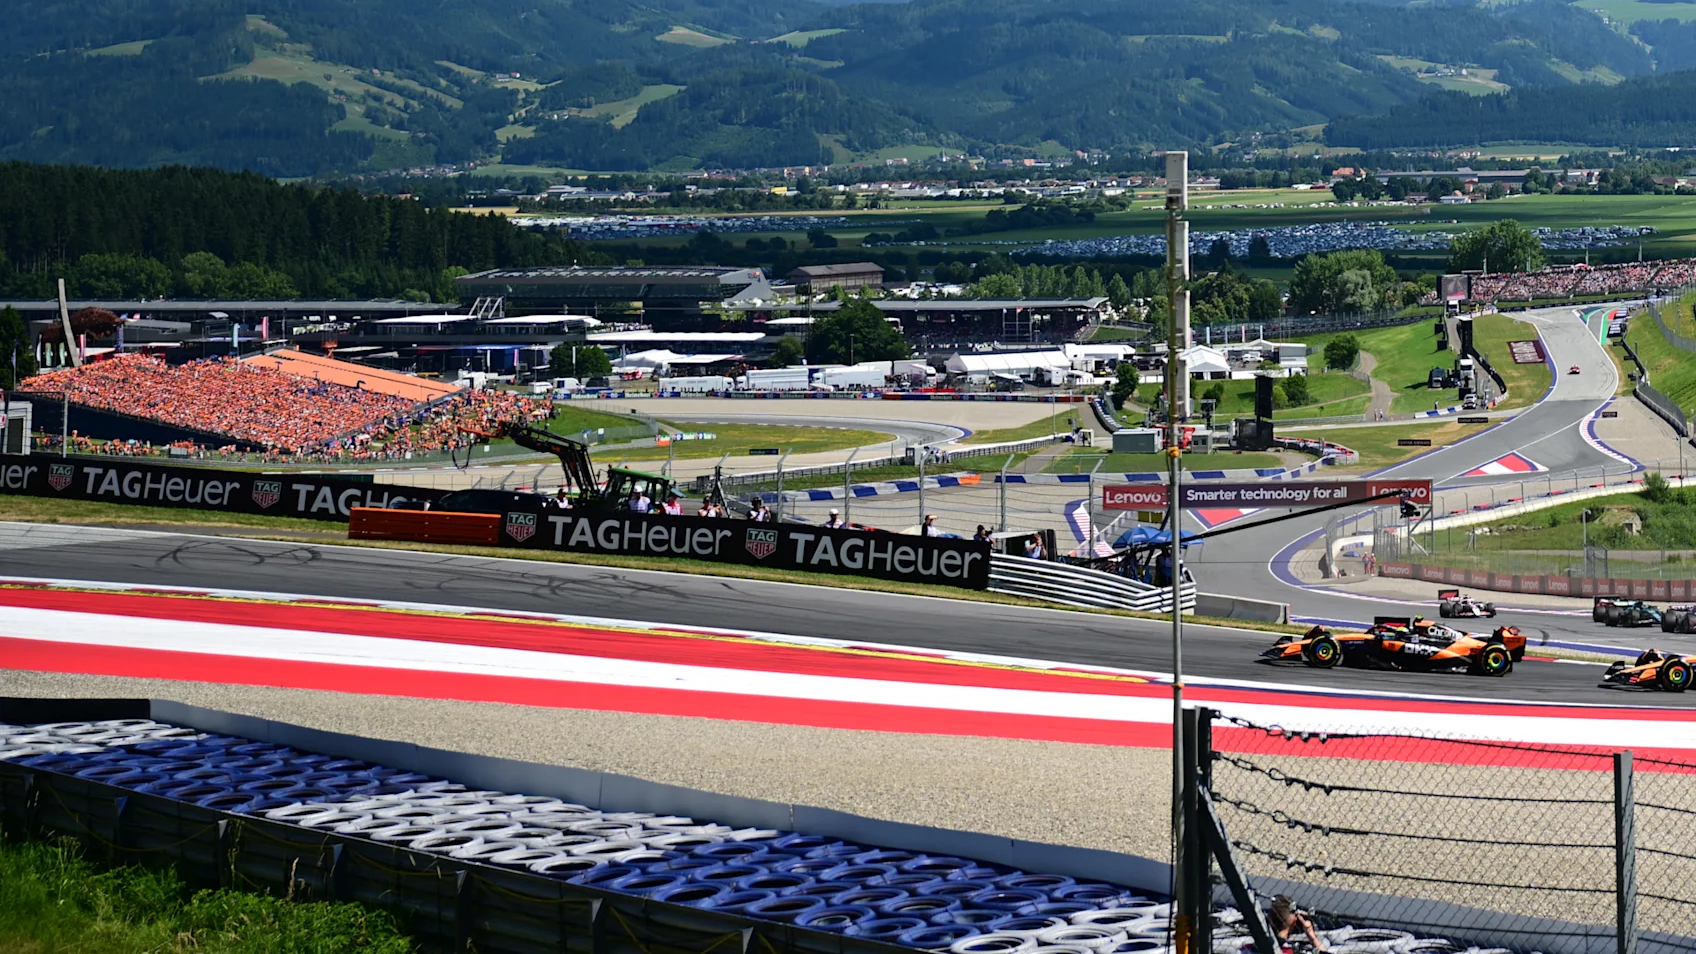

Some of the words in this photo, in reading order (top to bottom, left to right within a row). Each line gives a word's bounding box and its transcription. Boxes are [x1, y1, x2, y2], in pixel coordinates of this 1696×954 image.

[52, 467, 72, 476] TAG
[256, 482, 280, 493] TAG
[253, 492, 281, 507] HEUER
[292, 483, 431, 516] TAGH
[1105, 491, 1162, 504] Lenovo
[1186, 489, 1237, 501] Smarter
[1240, 487, 1311, 501] technology
[1313, 486, 1333, 499] for
[1333, 486, 1347, 498] all
[510, 514, 534, 525] TAG
[508, 525, 536, 541] HEUER
[750, 530, 775, 542] TAG
[747, 541, 775, 559] HEUER
[1428, 626, 1464, 640] Chrome
